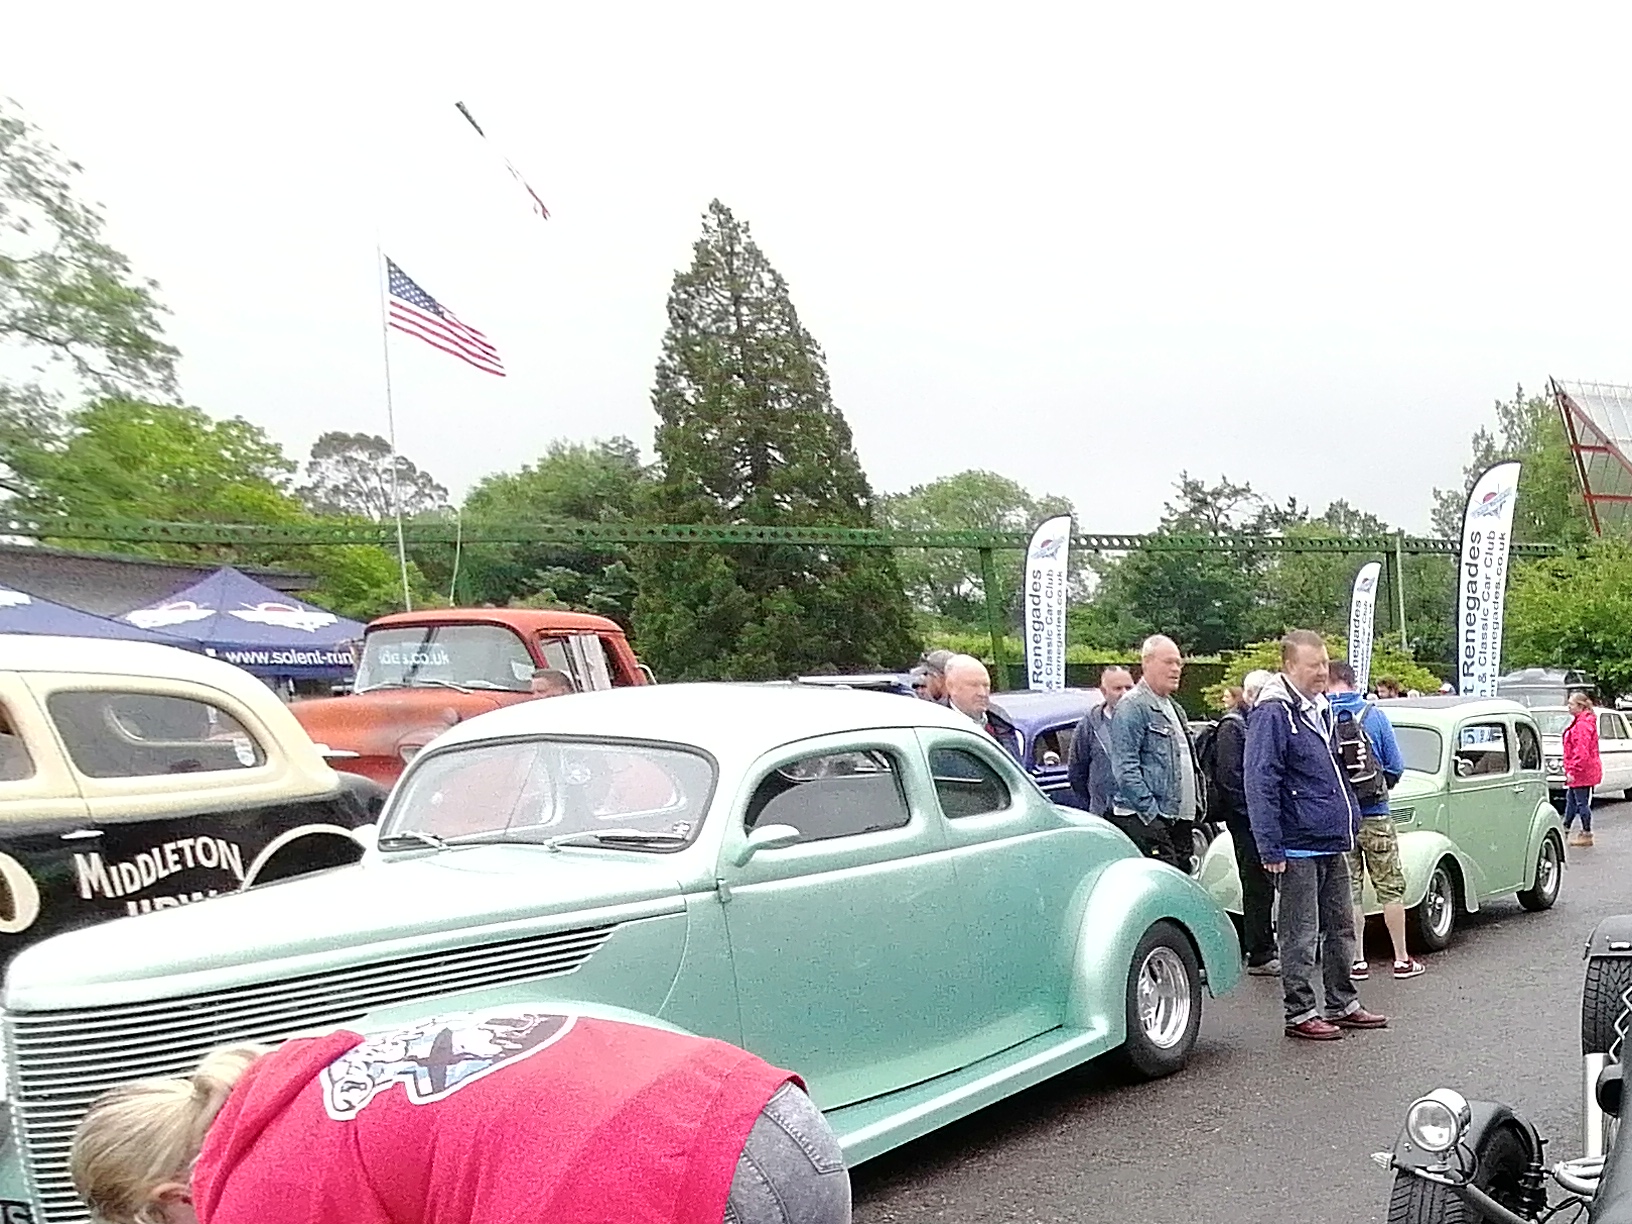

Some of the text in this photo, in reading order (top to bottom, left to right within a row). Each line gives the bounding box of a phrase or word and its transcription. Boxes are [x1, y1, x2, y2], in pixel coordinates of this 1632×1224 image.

[1484, 530, 1496, 567] Club
[1045, 569, 1054, 594] Club
[1463, 530, 1482, 678] Renegades
[1482, 574, 1492, 603] Car
[1029, 569, 1045, 685] Renegades
[1045, 604, 1054, 626] Car
[1478, 608, 1489, 667] Classic
[1352, 600, 1362, 684] enegades
